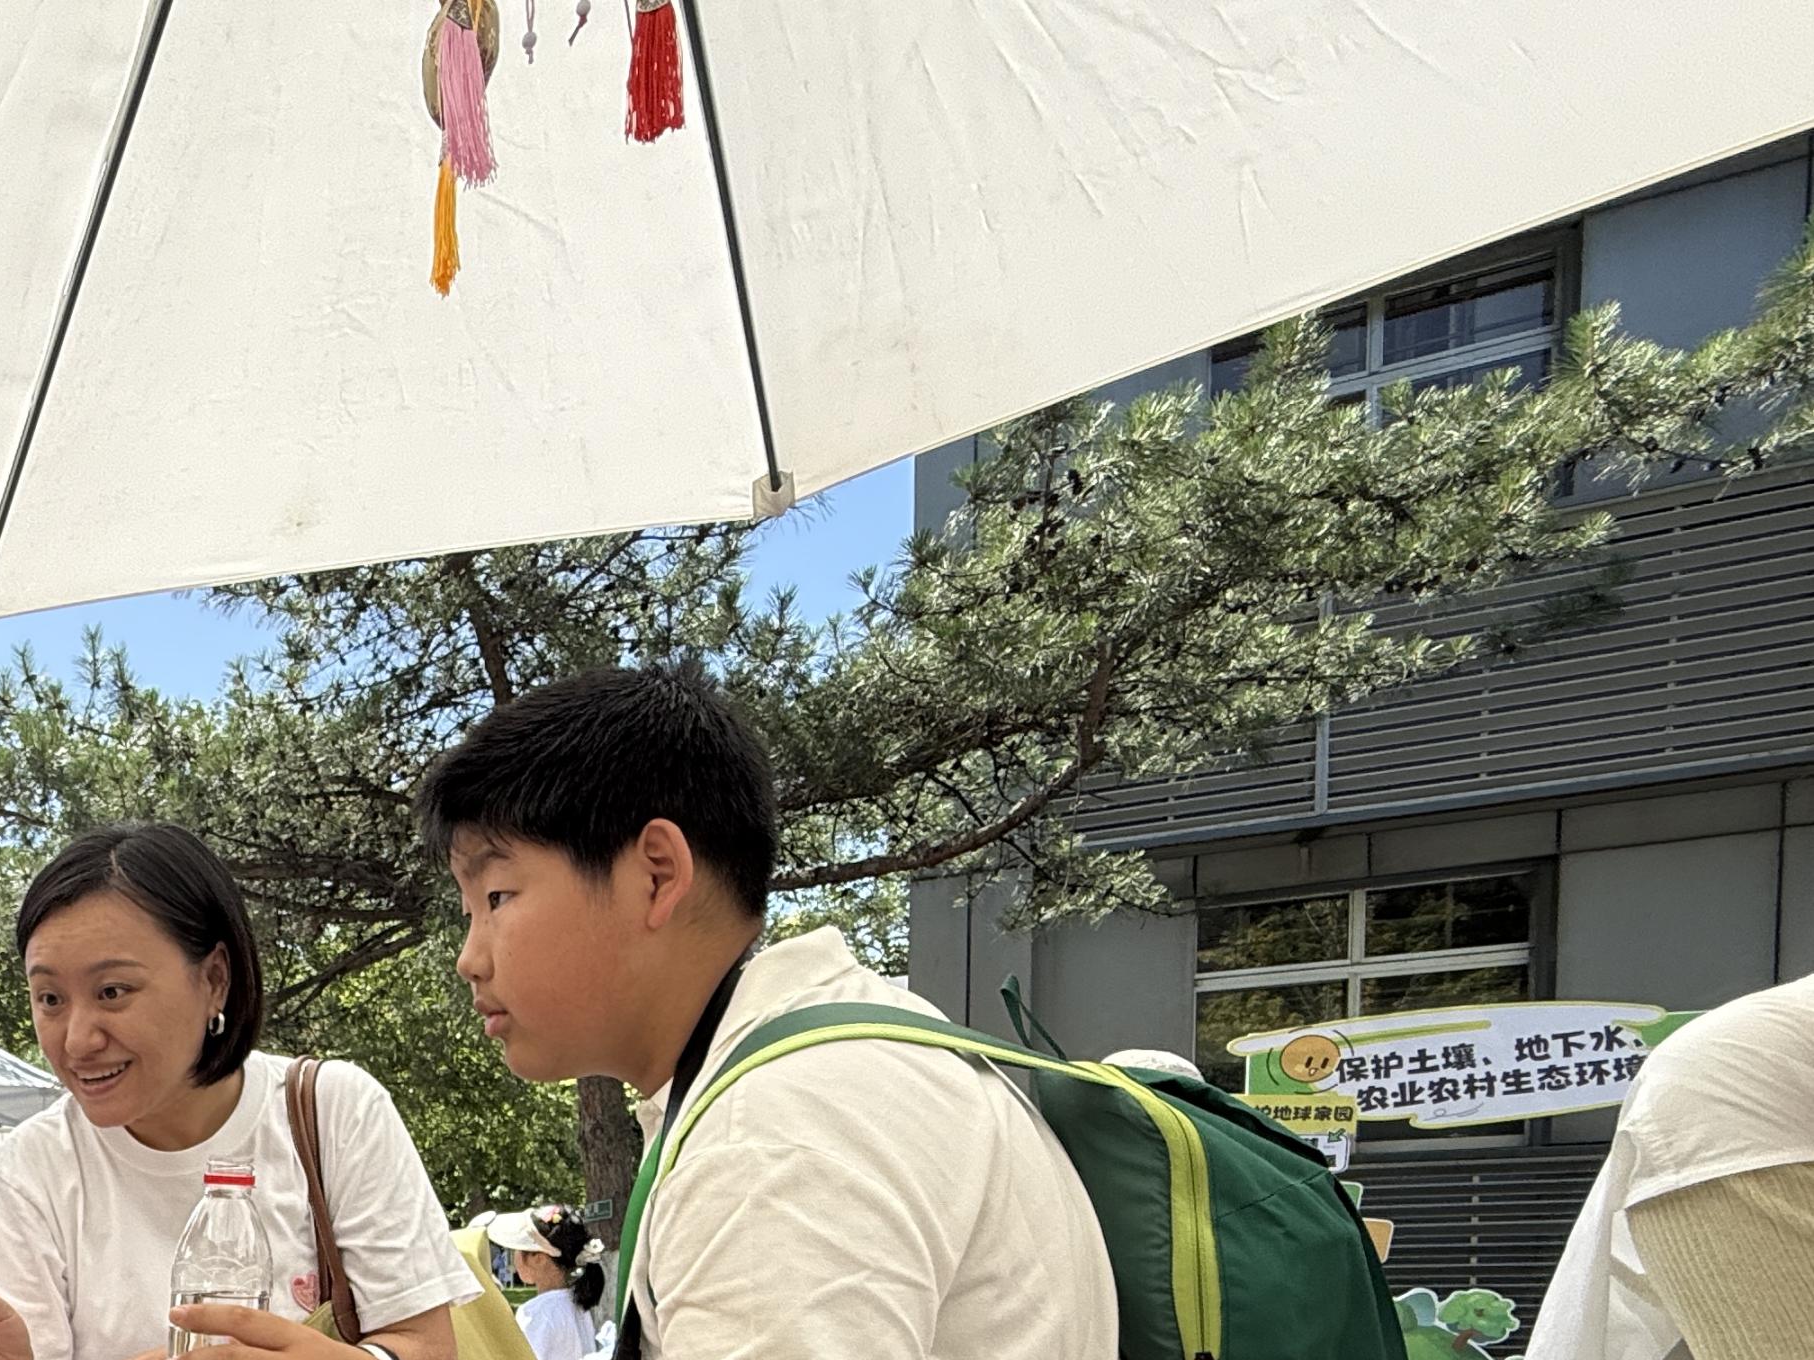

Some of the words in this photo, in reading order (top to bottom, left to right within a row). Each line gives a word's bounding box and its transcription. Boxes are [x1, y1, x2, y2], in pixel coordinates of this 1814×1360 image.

[1335, 1024, 1644, 1084] 保护土壤、地下水、
[1357, 1055, 1648, 1112] 农业农村生态环境
